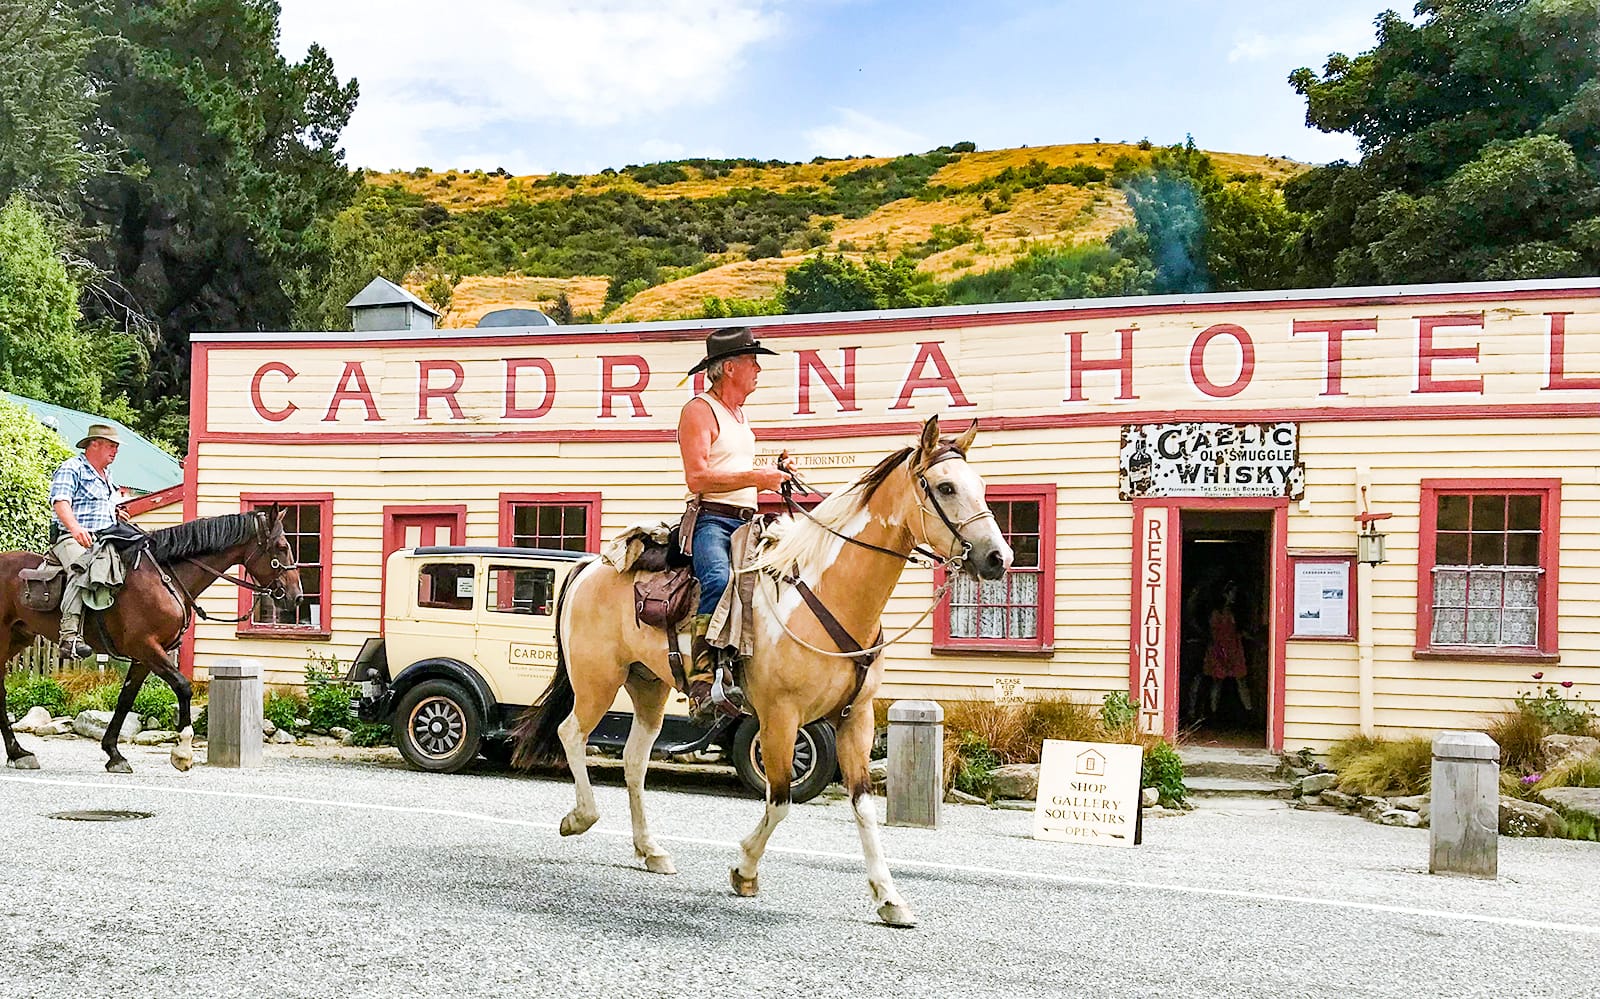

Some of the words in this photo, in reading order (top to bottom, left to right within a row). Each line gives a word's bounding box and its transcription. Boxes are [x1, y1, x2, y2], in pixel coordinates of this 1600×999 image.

[250, 339, 978, 422] CARDRNA
[1062, 309, 1600, 402] HOTEL
[805, 455, 856, 466] THORNTON
[1175, 463, 1294, 484] WHISKY
[1142, 519, 1162, 731] RESTAURANT
[1070, 782, 1107, 794] SHOP
[1052, 796, 1121, 811] GALLERY
[1045, 809, 1126, 825] SOUVENIRS
[1065, 826, 1099, 837] OPEN
